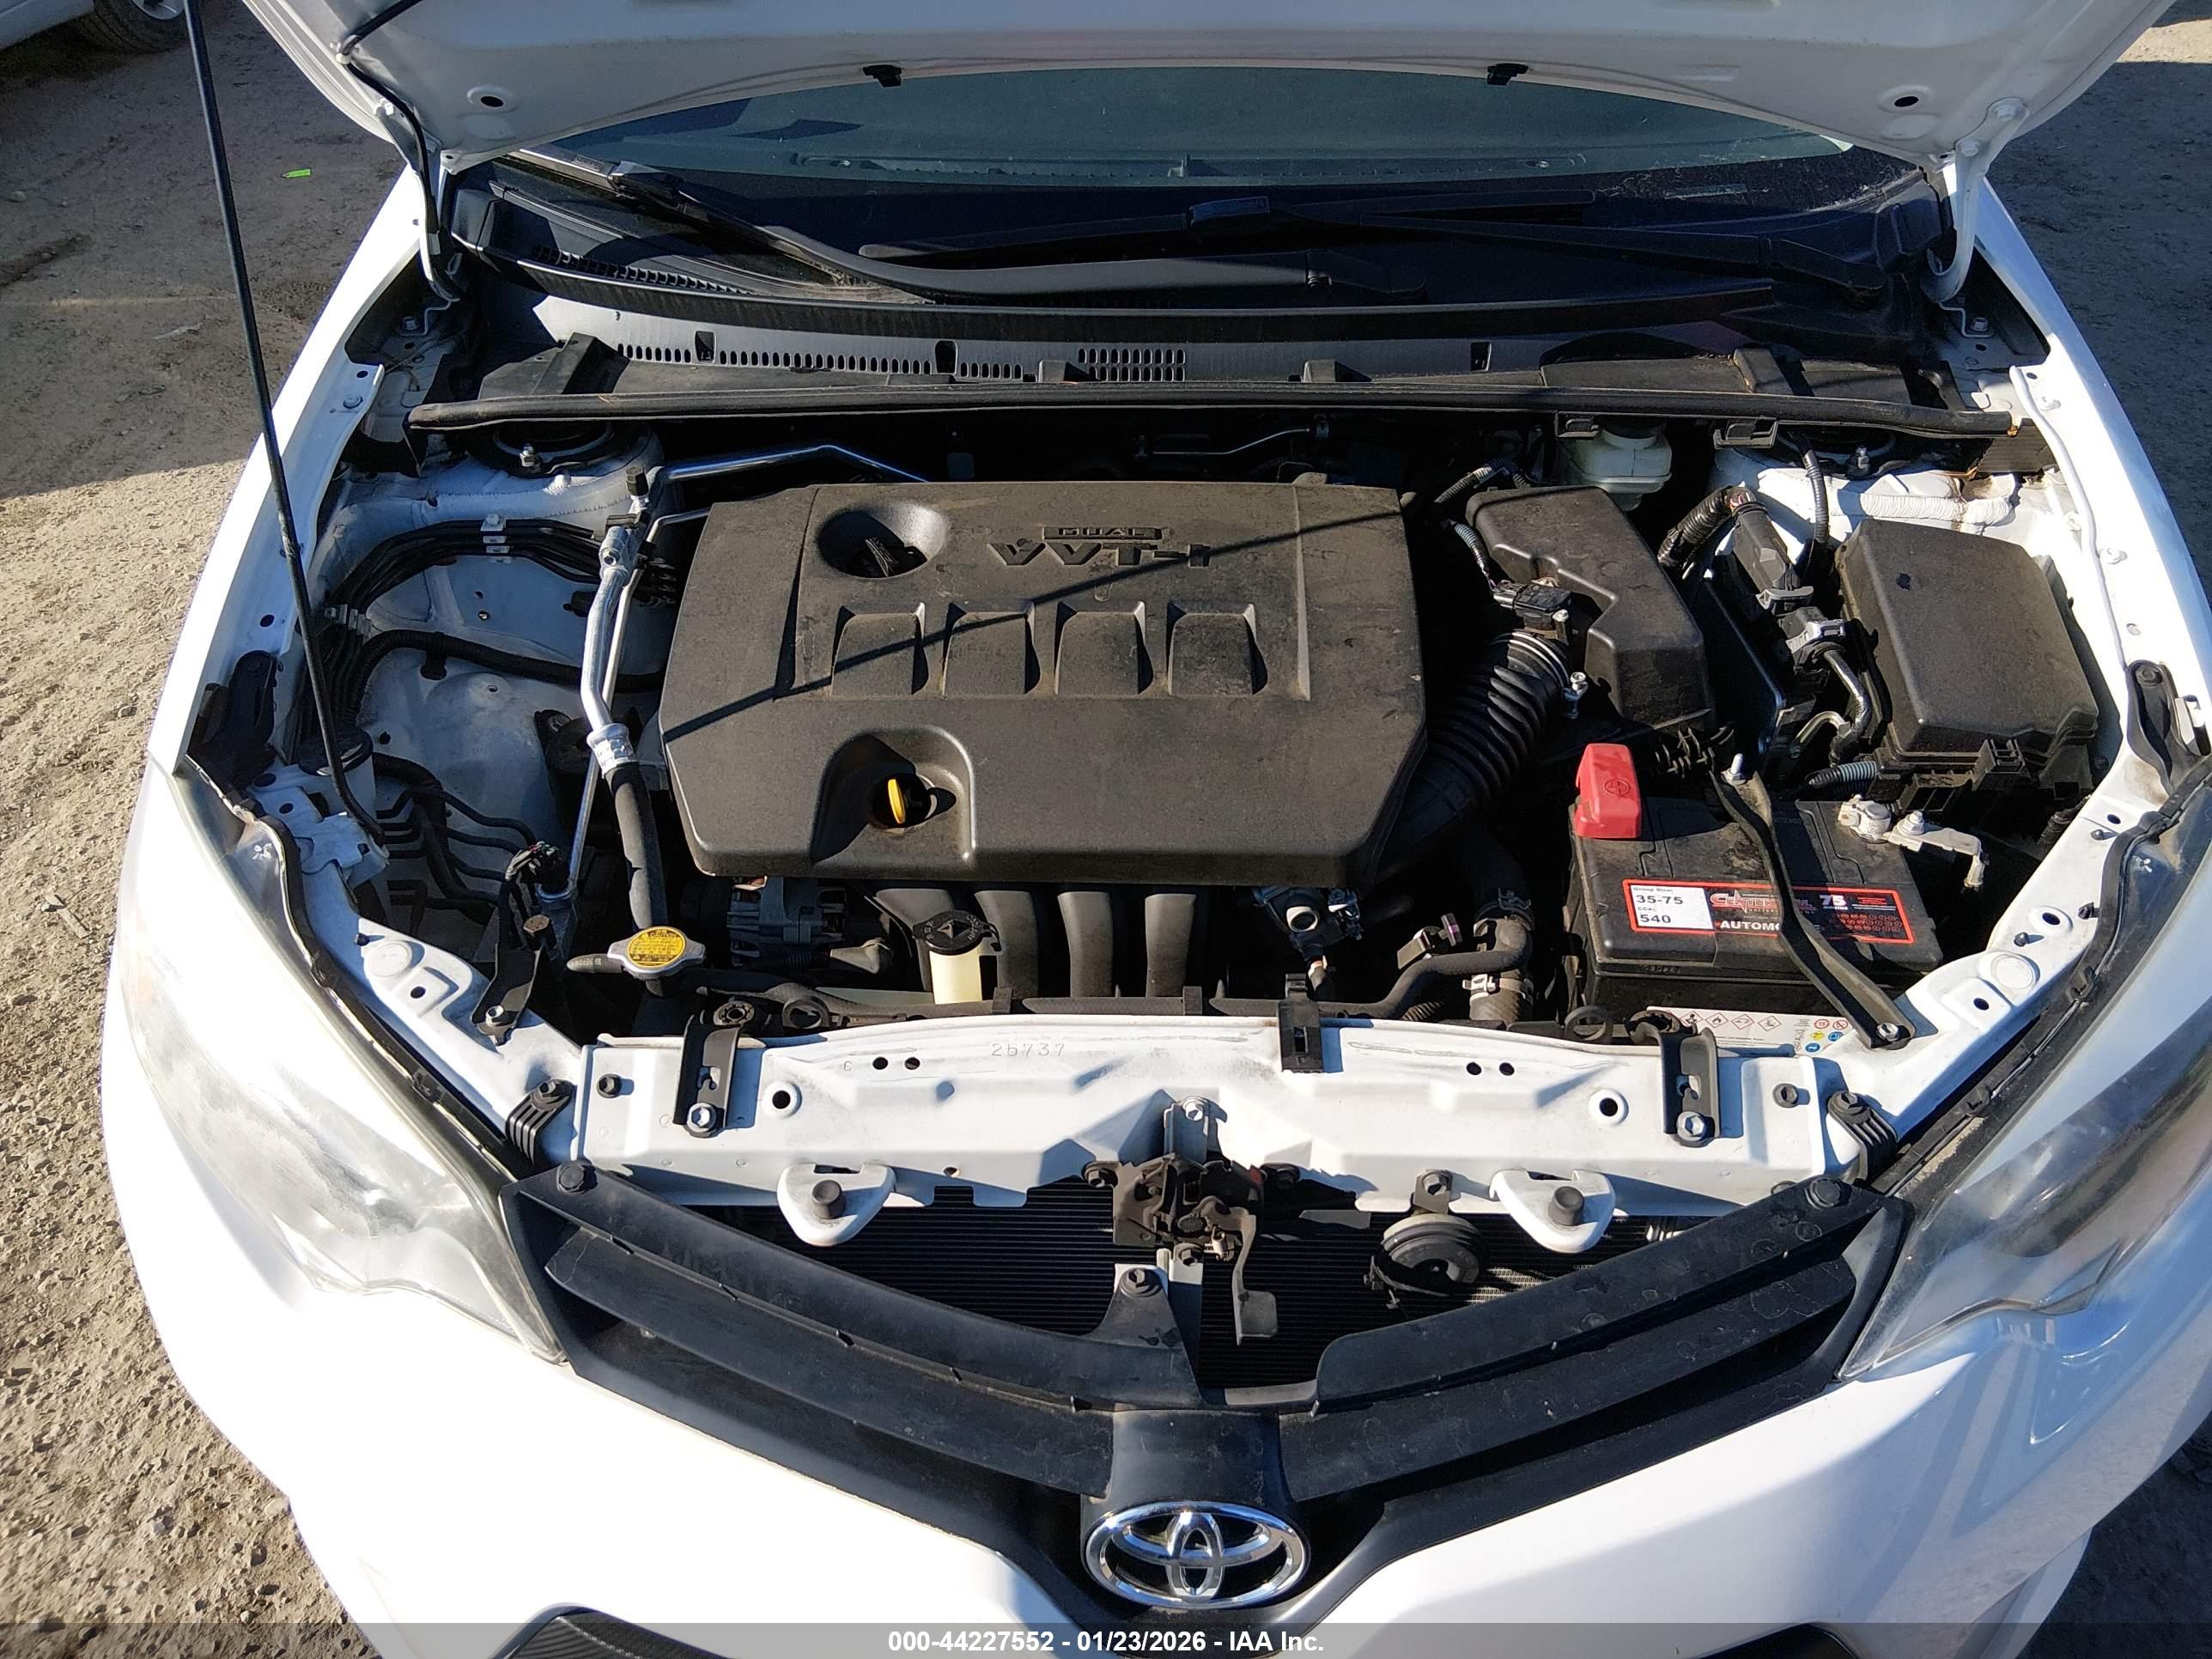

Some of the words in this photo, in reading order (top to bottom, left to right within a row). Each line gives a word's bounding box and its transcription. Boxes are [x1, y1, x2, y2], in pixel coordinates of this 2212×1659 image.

[1058, 526, 1146, 537] DUAL
[1636, 895, 1684, 905] 35-75
[1820, 895, 1847, 907] 75
[1640, 915, 1671, 923] 540
